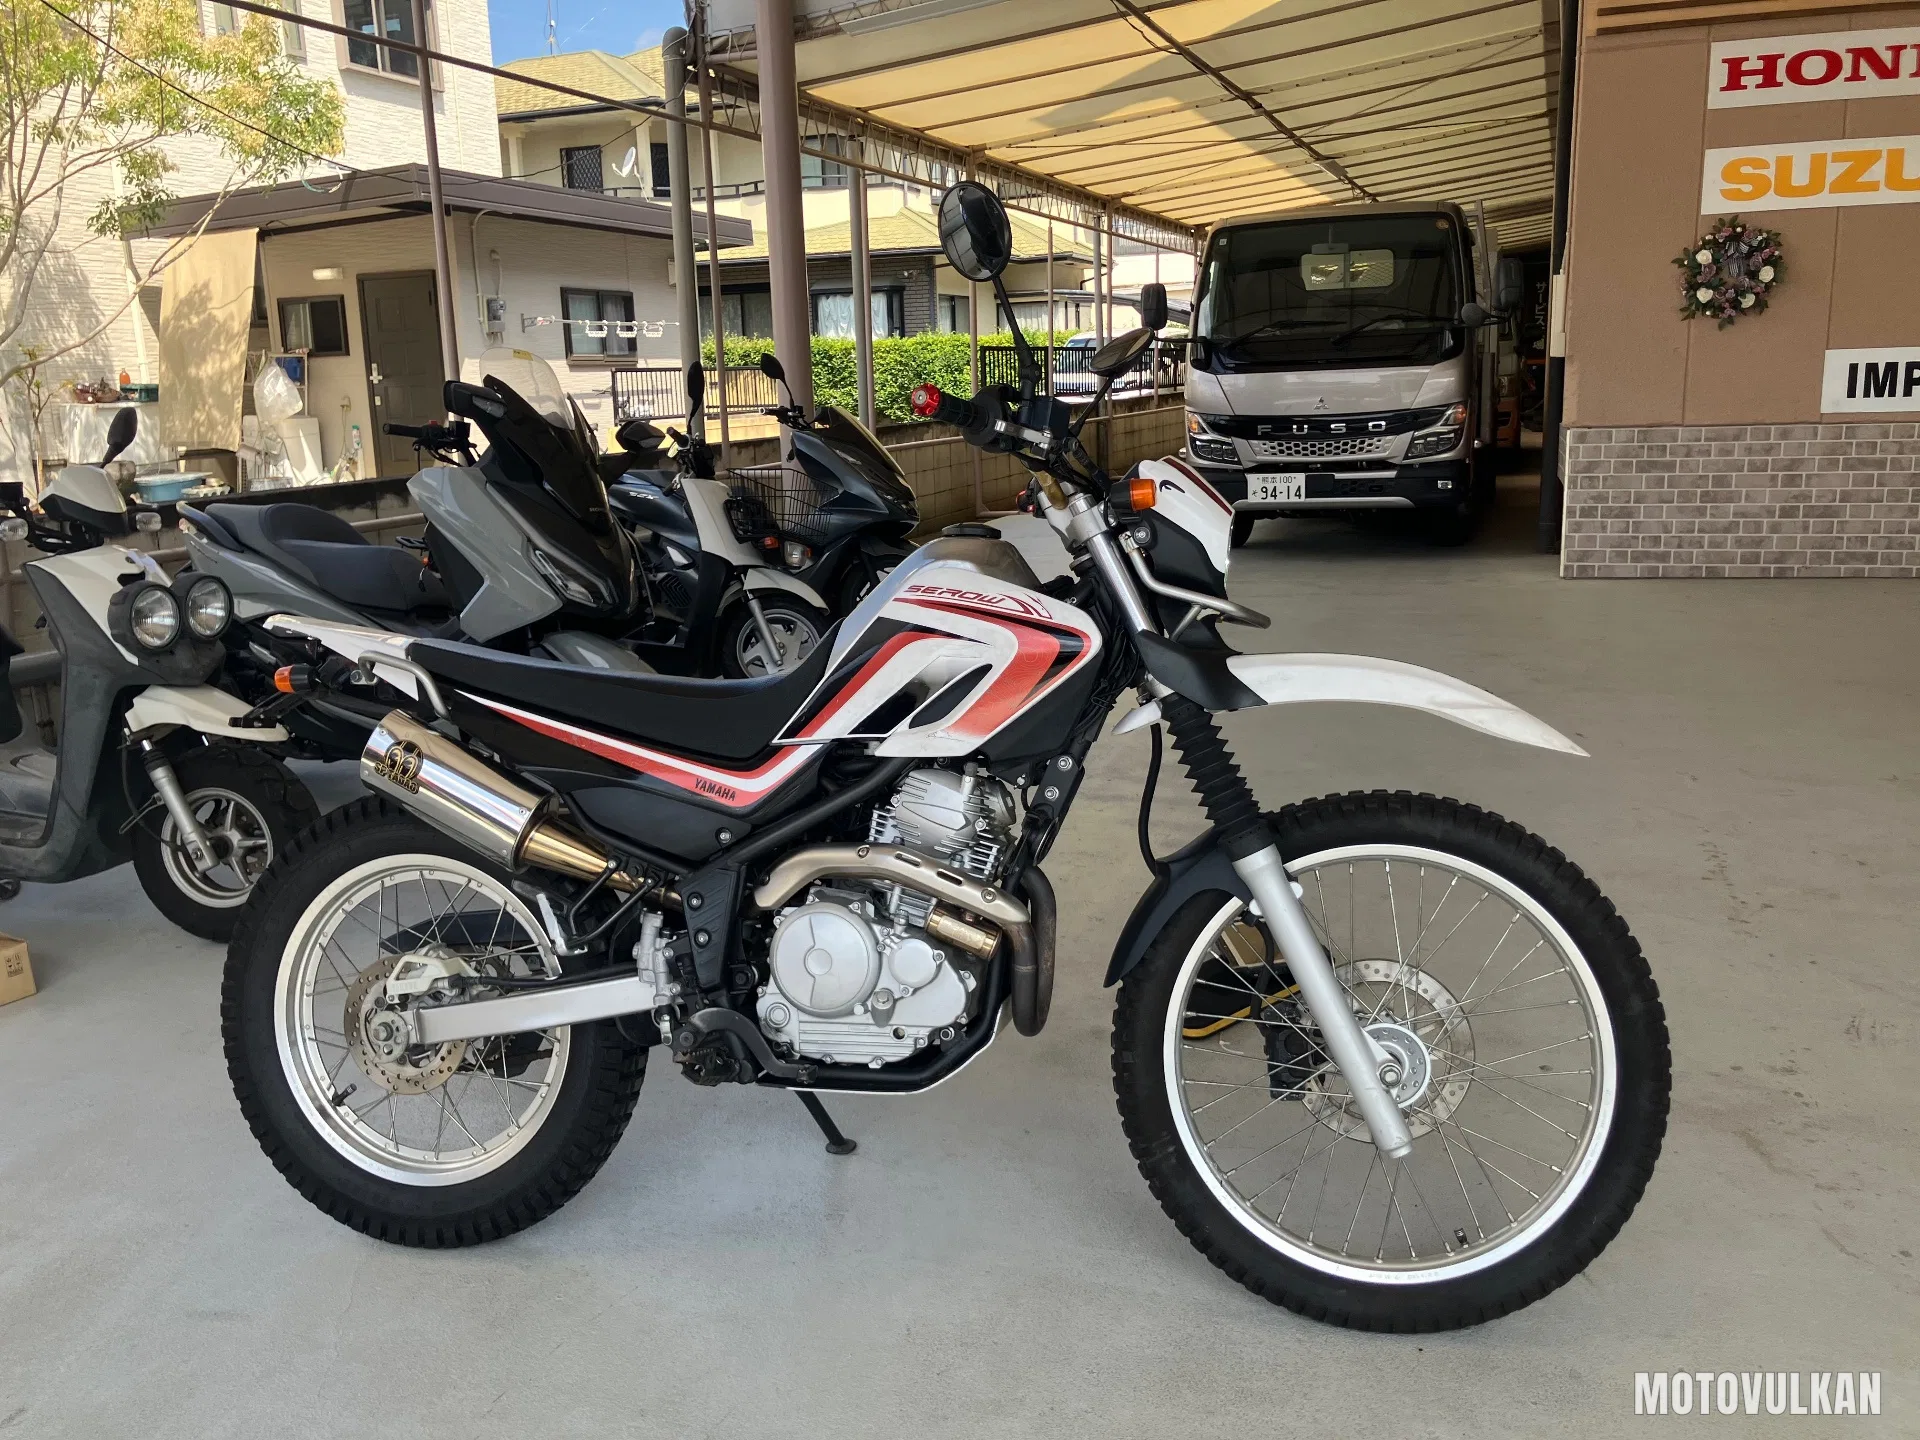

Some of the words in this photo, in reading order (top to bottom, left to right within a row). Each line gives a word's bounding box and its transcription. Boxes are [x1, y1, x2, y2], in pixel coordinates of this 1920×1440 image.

[1719, 43, 1920, 92] HON
[1719, 147, 1920, 202] SUZU
[1257, 421, 1387, 436] FUSO
[1260, 484, 1302, 500] 94-14
[903, 584, 1007, 605] SEROW
[695, 778, 736, 801] YAMAHA
